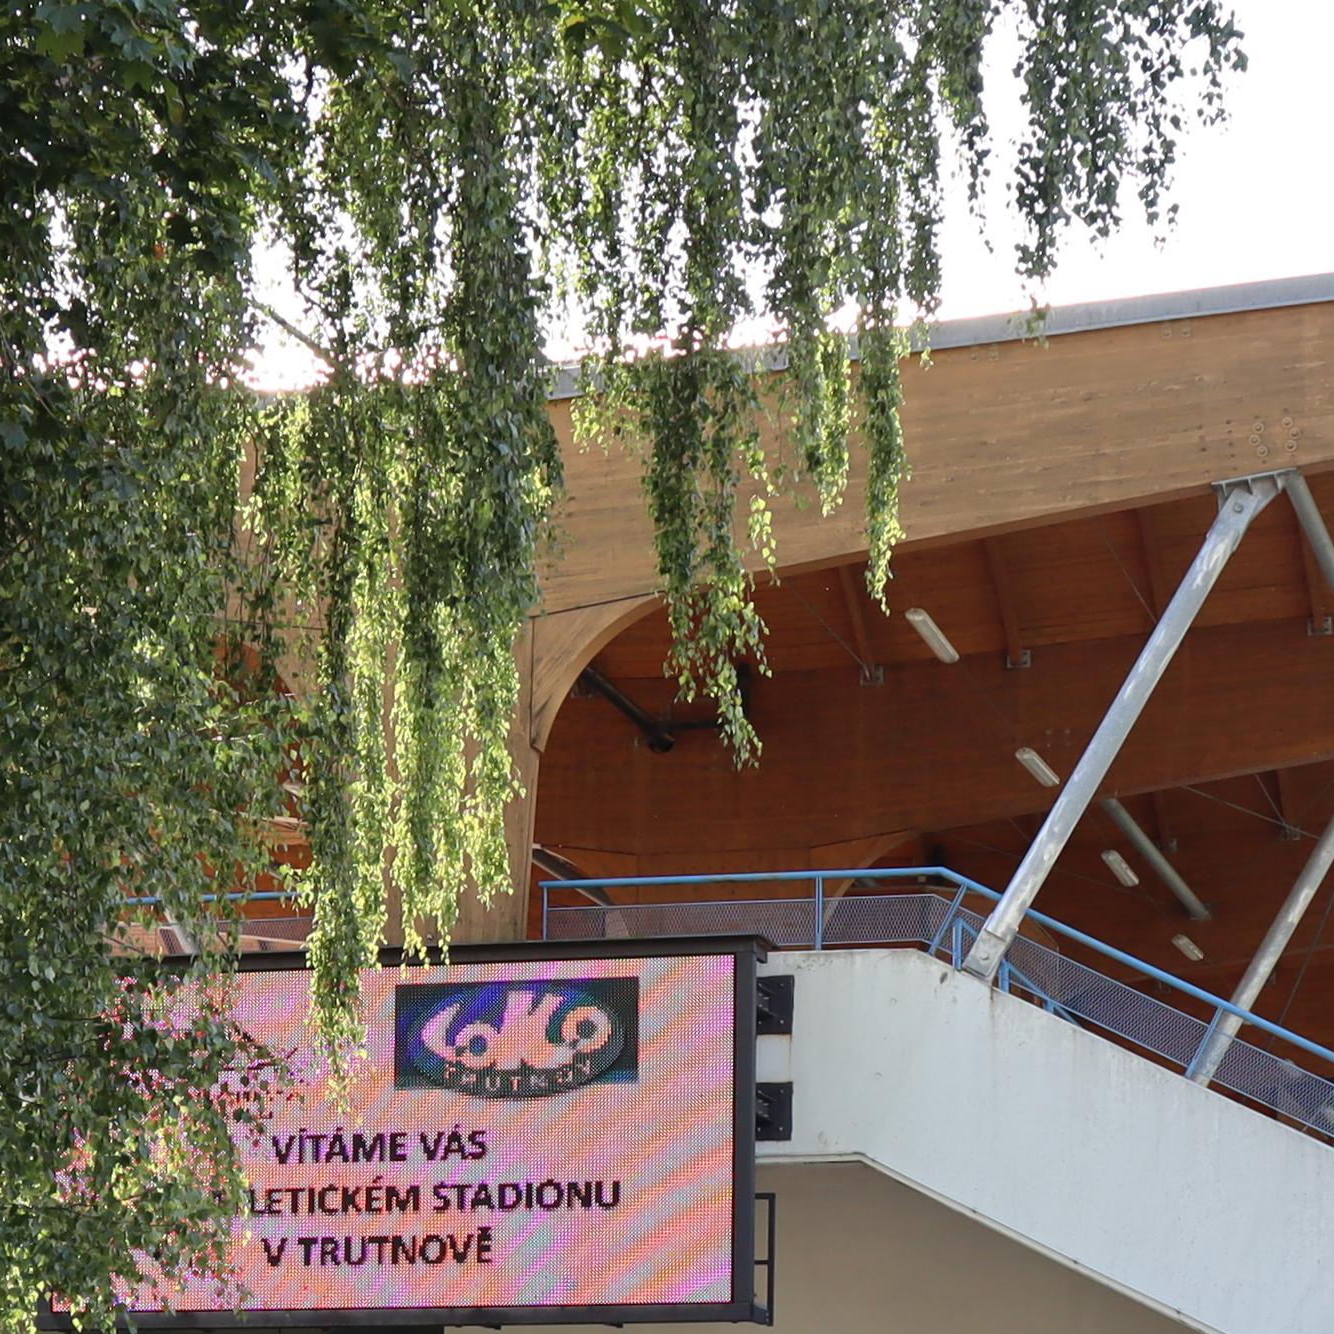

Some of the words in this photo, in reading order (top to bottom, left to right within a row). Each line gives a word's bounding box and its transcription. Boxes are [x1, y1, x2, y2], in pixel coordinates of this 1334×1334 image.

[443, 1058, 593, 1092] TRUTNOV
[272, 1126, 409, 1164] VÍTÁME
[420, 1124, 488, 1161] VÁS
[213, 1175, 421, 1215] LETICKÉM
[432, 1179, 622, 1212] STADIONU
[262, 1236, 286, 1267] V
[298, 1226, 493, 1267] TRUTNOVĚ
